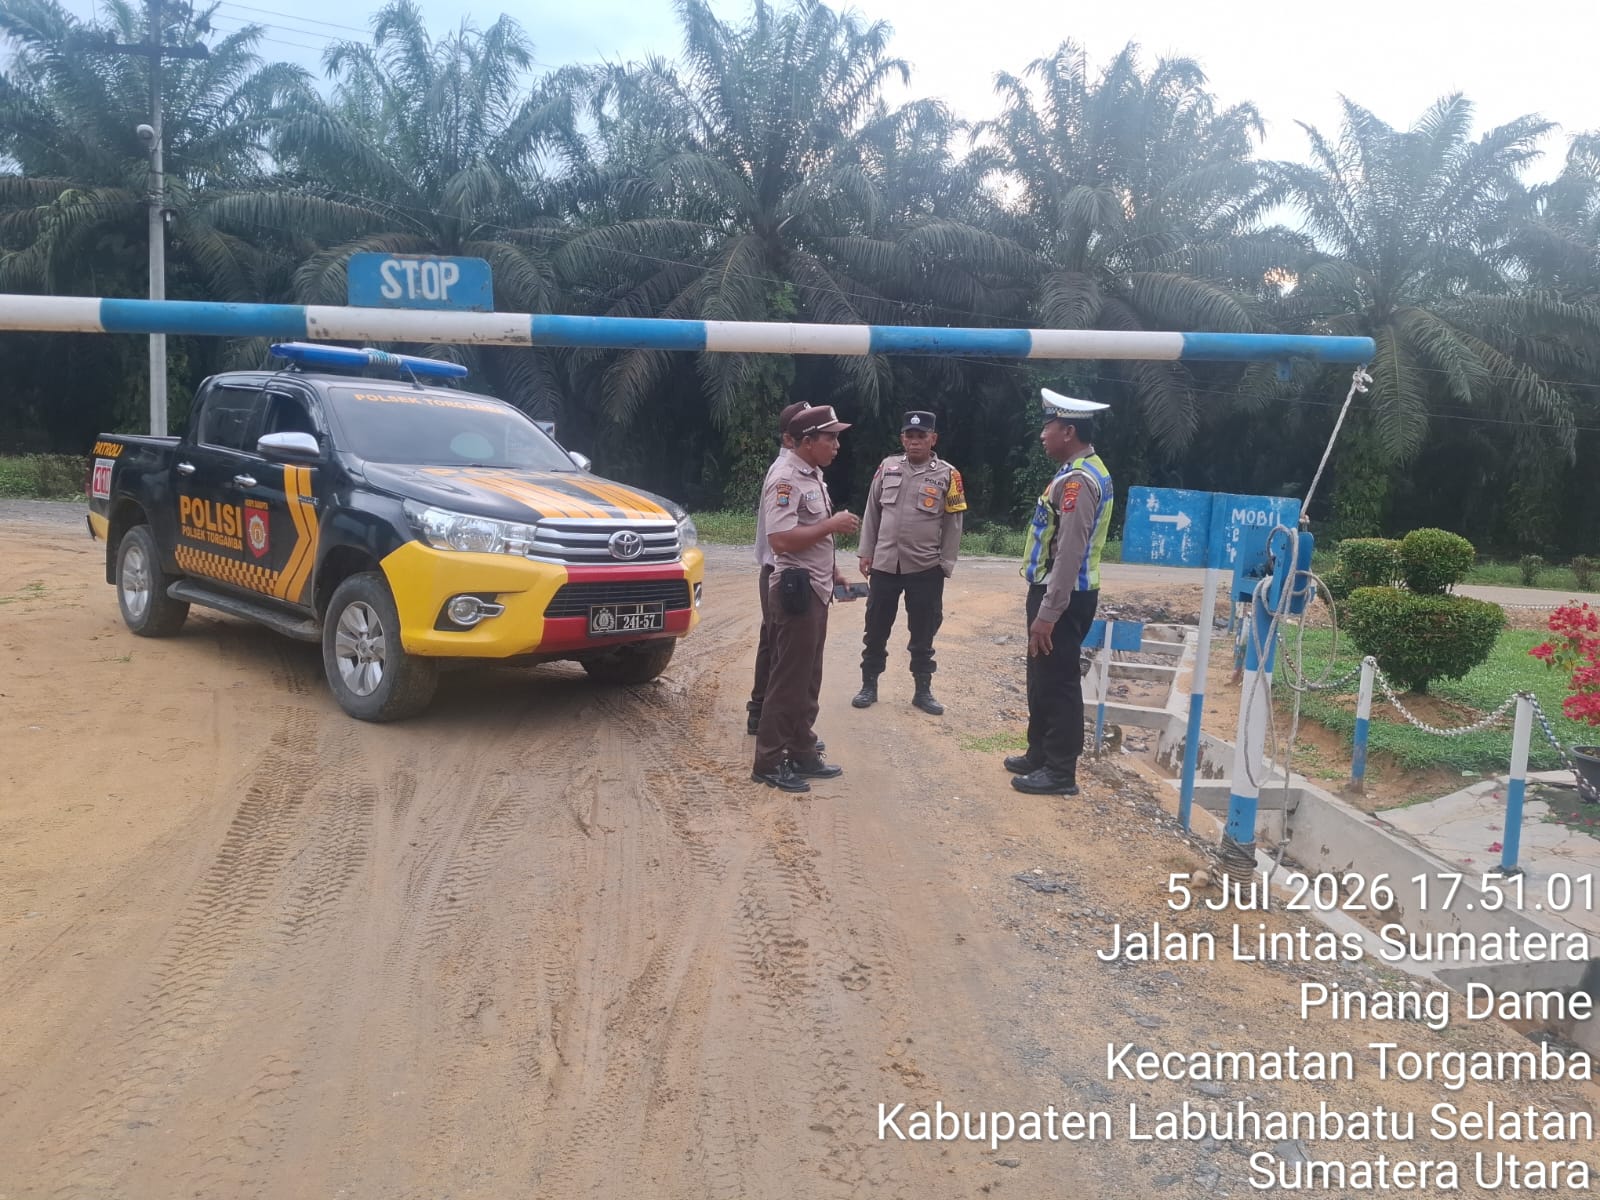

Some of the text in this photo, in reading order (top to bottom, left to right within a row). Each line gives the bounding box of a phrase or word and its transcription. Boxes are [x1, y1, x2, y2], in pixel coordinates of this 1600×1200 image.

[380, 259, 460, 300] STOP
[354, 393, 421, 405] POLSEK
[180, 494, 243, 538] POLISI
[182, 525, 243, 552] POLSEK TORGAMBA
[623, 614, 656, 630] 241-57
